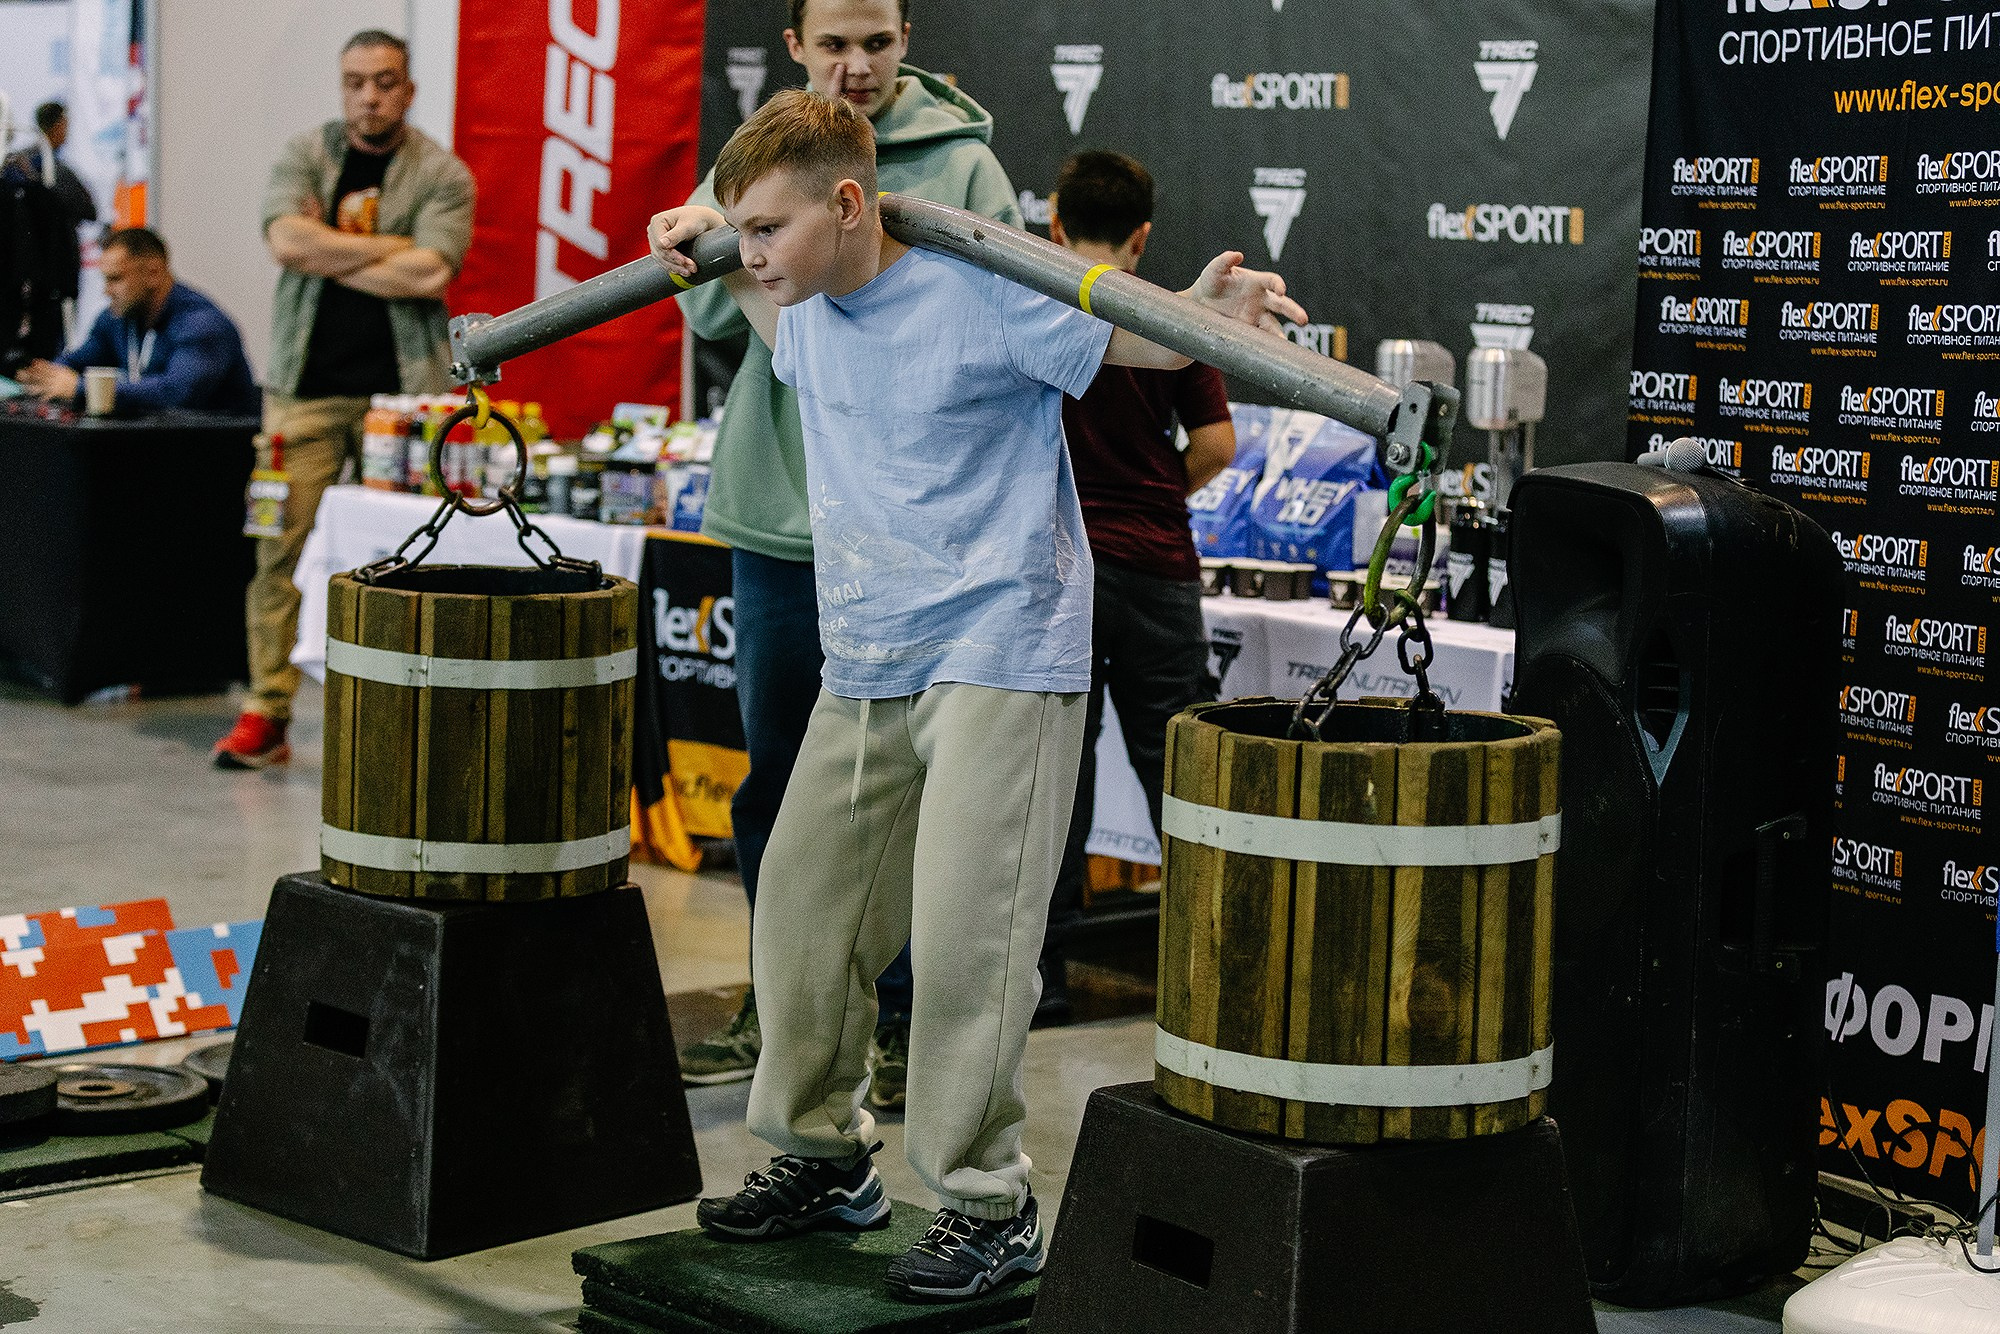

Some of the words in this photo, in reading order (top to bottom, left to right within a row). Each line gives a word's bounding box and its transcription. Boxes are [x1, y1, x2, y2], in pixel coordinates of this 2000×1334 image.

[1719, 17, 1933, 66] СПОРТИВНОЕ
[1789, 155, 1880, 183] flexSPORT
[1916, 182, 1977, 194] СПОРТИВНОЕ
[1850, 231, 1943, 259] flexSPORT
[1848, 261, 1906, 272] СПОРТИВНОЕ
[1908, 262, 1950, 272] ПИТАНИЕ
[1781, 301, 1872, 330] flexSPORT
[1906, 334, 1972, 346] СПОРТИВНОЕ
[1840, 385, 1936, 416] flexSPORT
[1898, 418, 1942, 430] ПИТАНИЕ
[1772, 445, 1862, 477] flexSPORT
[1901, 455, 1990, 486] flexSPORT
[1899, 484, 1952, 498] СПОРТИВНОЕ
[1954, 488, 1997, 501] ПИТАНИЕ
[1886, 615, 1978, 652] flexSPORT
[1884, 644, 1940, 662] СПОРТИВНОЕ
[1942, 653, 1984, 667] ПИТАНИЕ
[1874, 762, 1972, 804] flexSPORT
[1872, 791, 1928, 812] СПОРТИВНОЕ
[1930, 803, 1982, 820] ПИТАНИЕ
[1824, 971, 1995, 1074] ФОР
